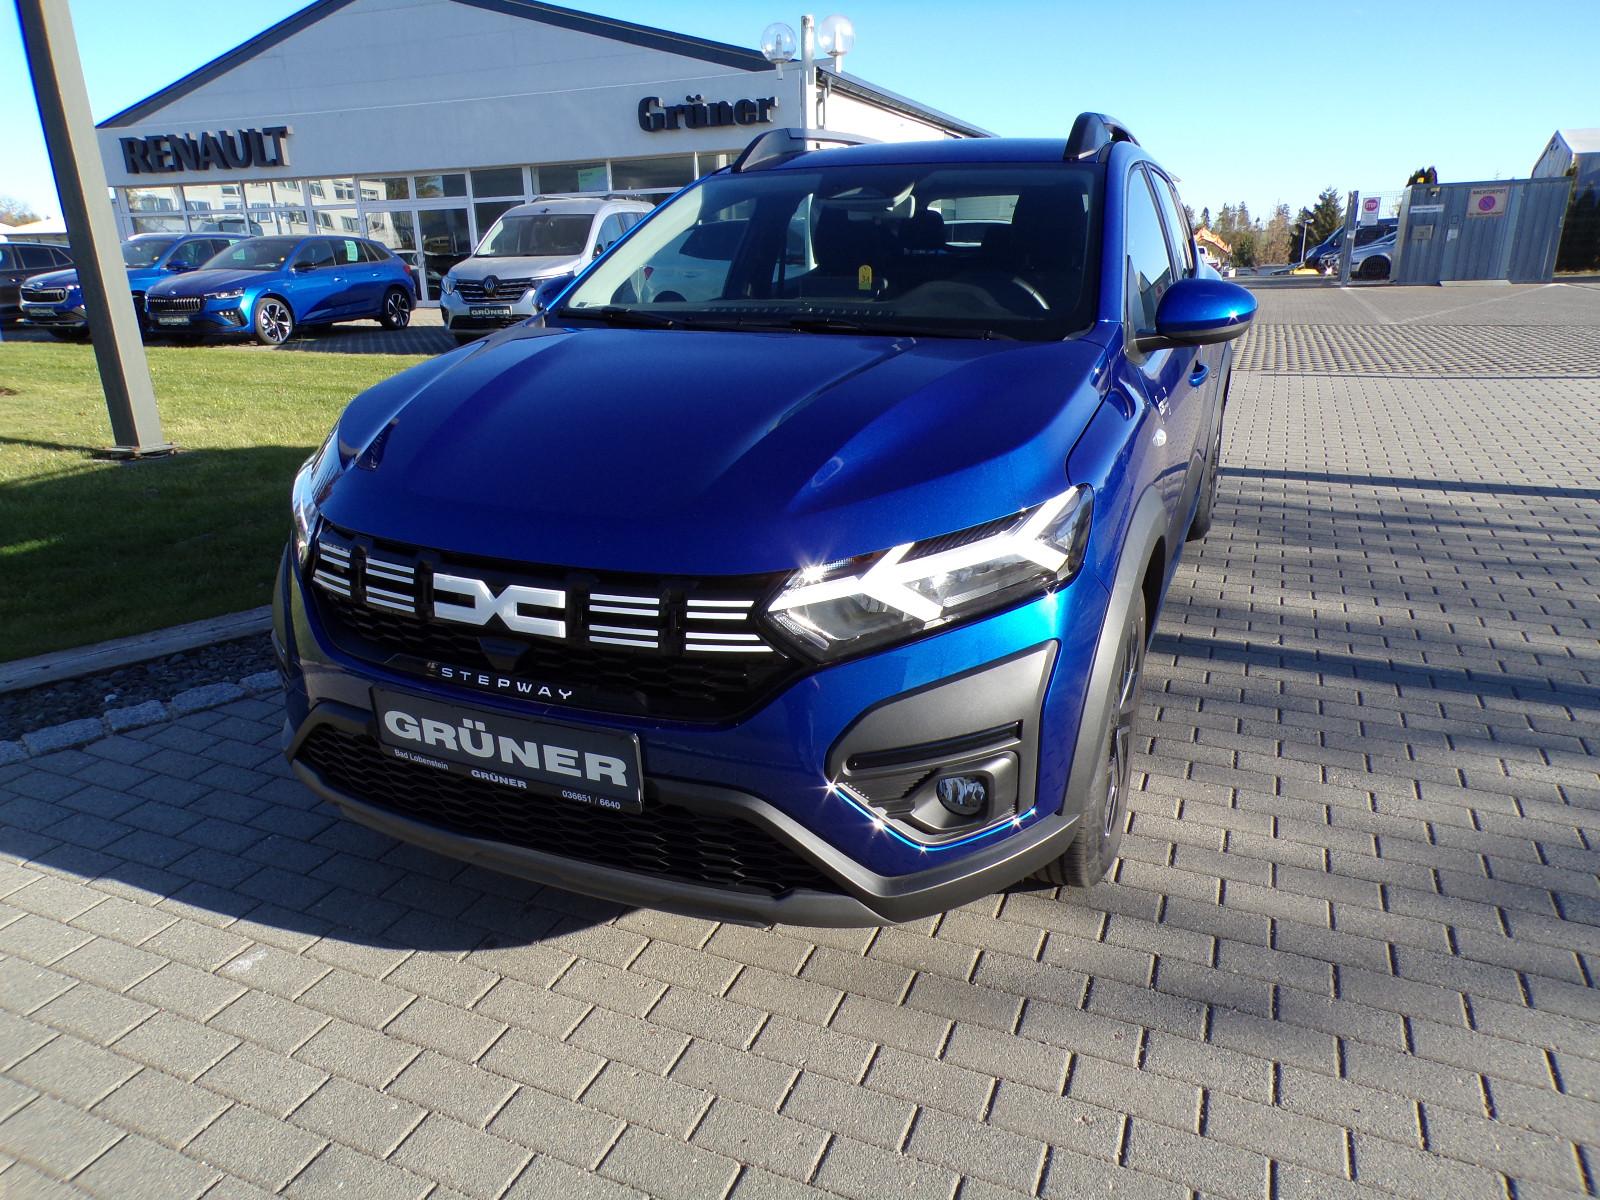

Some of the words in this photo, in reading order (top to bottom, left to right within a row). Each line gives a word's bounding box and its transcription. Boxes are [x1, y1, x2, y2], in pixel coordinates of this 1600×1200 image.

[638, 94, 778, 132] Grüner
[119, 126, 293, 174] RENAULT
[1364, 202, 1378, 210] STOP
[441, 667, 573, 700] STEPWAY
[384, 710, 628, 787] GRÜNER
[394, 748, 409, 759] Bad
[409, 752, 449, 771] Lobenstein
[471, 769, 528, 789] GRÜNER
[599, 798, 621, 810] 6640
